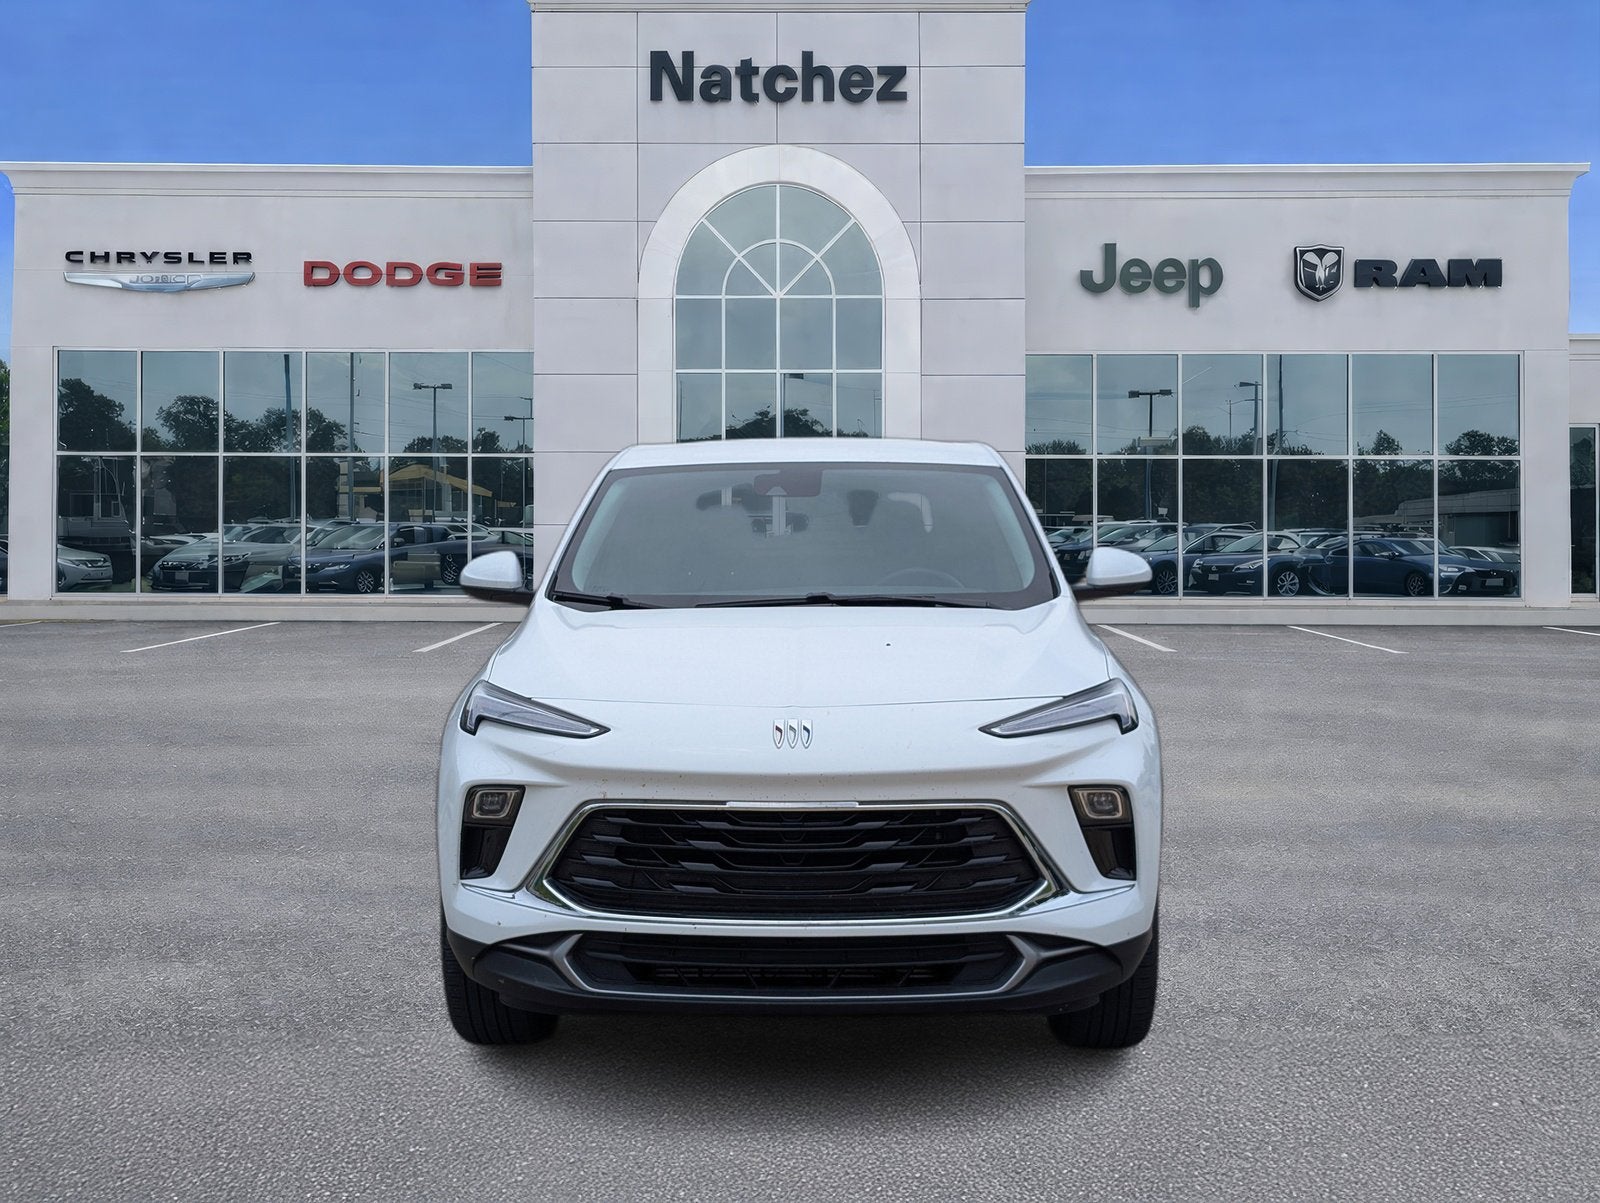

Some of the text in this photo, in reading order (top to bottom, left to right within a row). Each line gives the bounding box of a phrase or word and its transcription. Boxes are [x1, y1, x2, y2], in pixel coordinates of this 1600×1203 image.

[650, 51, 907, 103] Natchez
[65, 250, 253, 265] CHRYSLER
[303, 261, 502, 287] DODGE
[1080, 243, 1223, 308] Jeep
[1354, 258, 1503, 287] RAM
